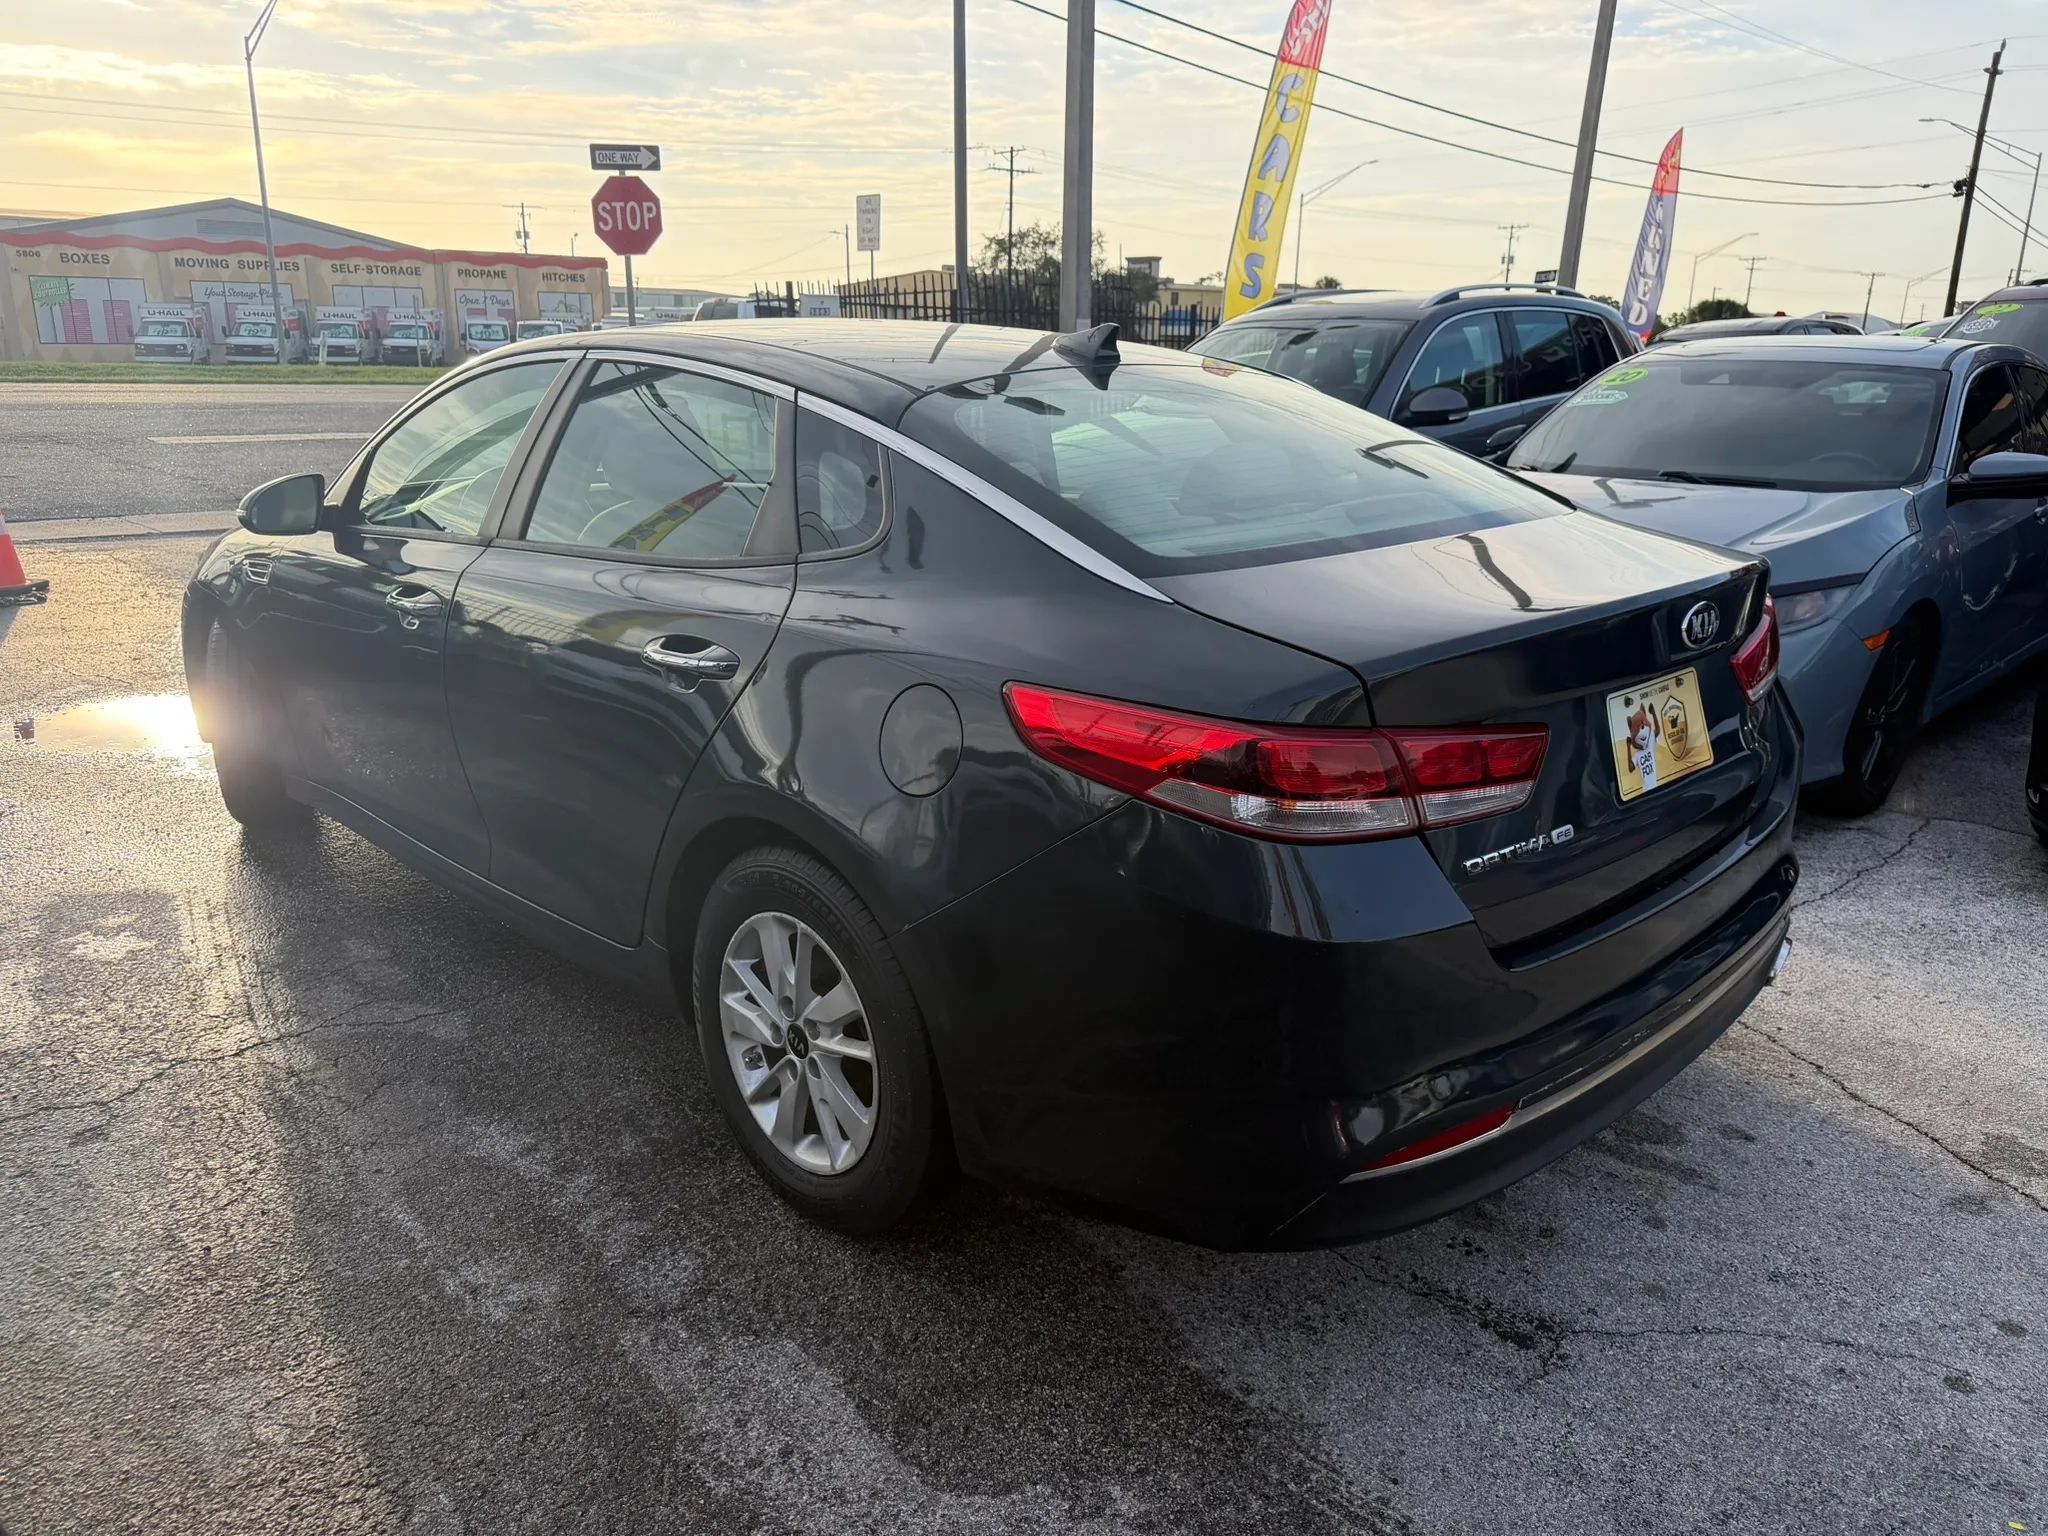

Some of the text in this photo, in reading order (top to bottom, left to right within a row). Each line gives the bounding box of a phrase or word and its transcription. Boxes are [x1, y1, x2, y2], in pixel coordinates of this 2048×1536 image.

[597, 152, 640, 163] ONE WAY
[1240, 73, 1304, 299] CARS
[597, 201, 657, 231] STOP
[60, 252, 111, 265] BOXES
[174, 257, 300, 272] MOVING SUPPIES
[330, 263, 422, 277] SELF-STORAGE
[457, 268, 508, 280] PROPANE
[542, 271, 586, 283] HITCHES
[1640, 752, 1652, 766] CAR
[1642, 763, 1655, 777] FOX
[1461, 828, 1572, 876] OPTIMA FE
